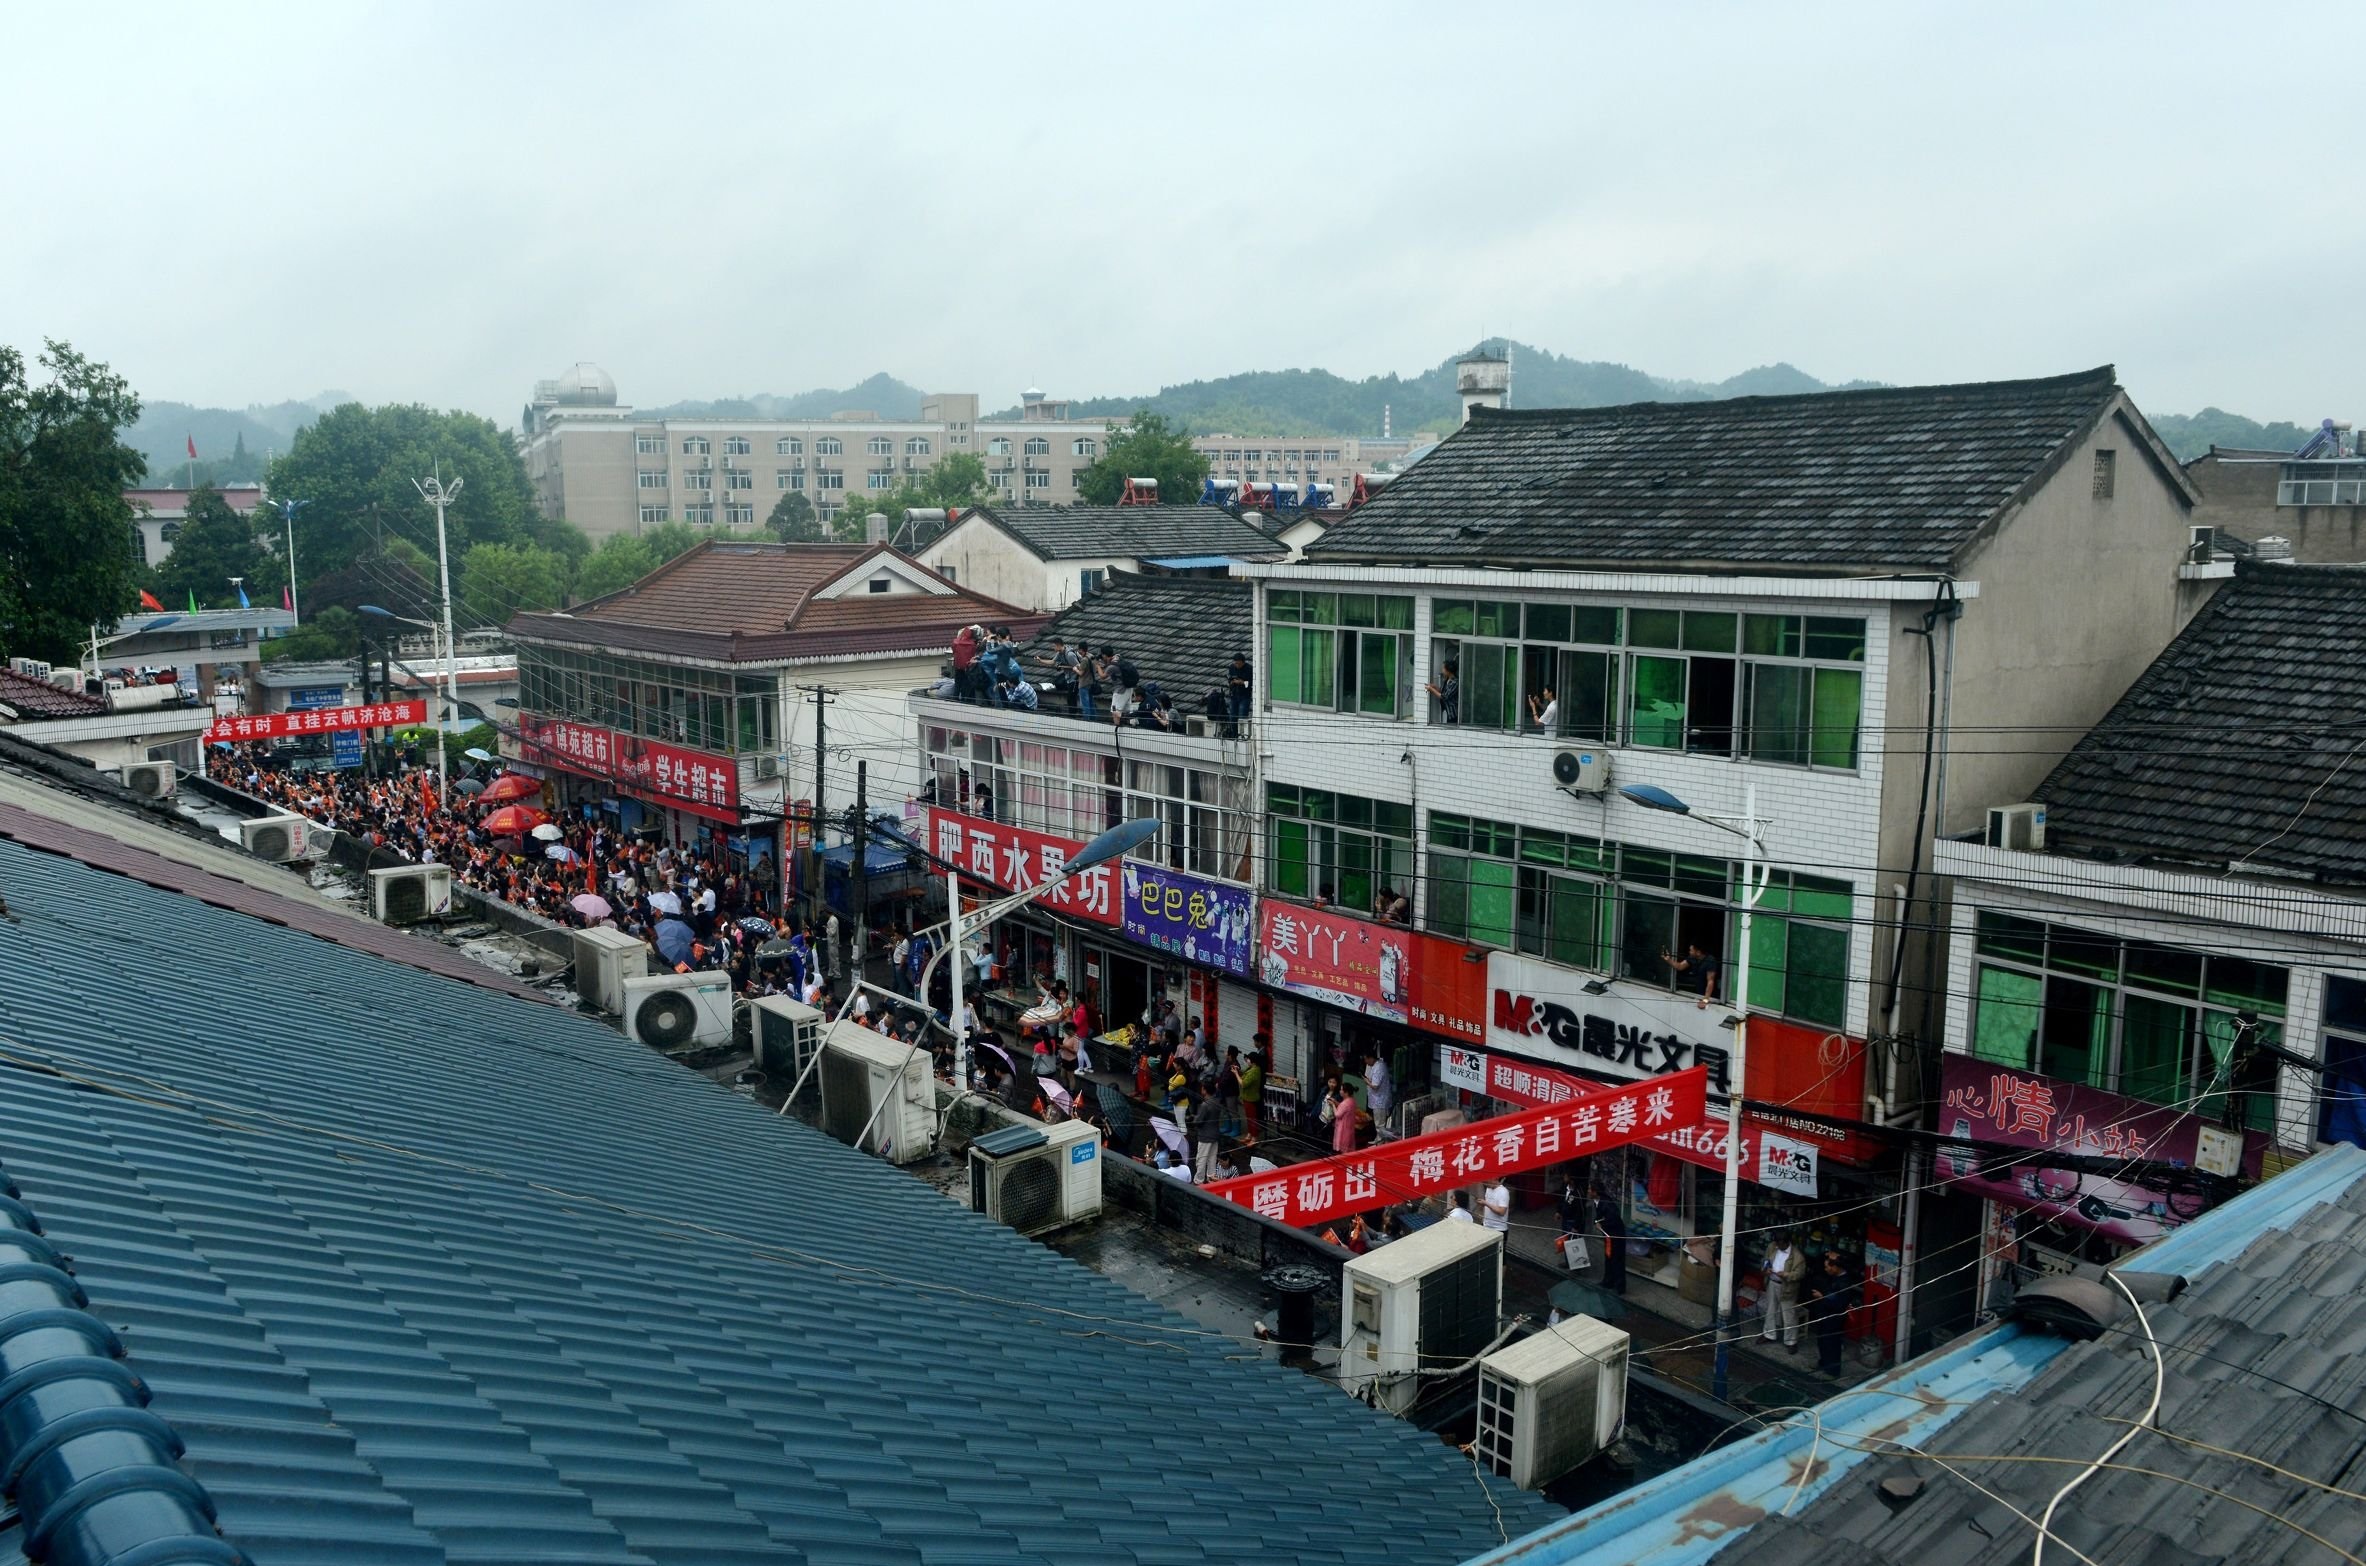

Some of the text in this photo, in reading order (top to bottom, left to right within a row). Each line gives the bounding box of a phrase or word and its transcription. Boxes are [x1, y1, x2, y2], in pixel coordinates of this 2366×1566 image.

[286, 705, 410, 730] 直挂云帆济沧海
[555, 724, 607, 762] 博苑超市
[656, 755, 726, 806] 学生超市
[938, 819, 1111, 915] 肥西水果坊
[1142, 881, 1207, 929] 巴巴兔
[1127, 920, 1145, 935] 时尚
[1271, 912, 1347, 966] 美丫丫
[1329, 975, 1349, 987] 工艺品
[1411, 1006, 1482, 1036] 时尚 文具 礼品 饰品
[1494, 988, 1580, 1049] M&G
[1450, 1050, 1480, 1071] M&G
[1582, 1013, 1732, 1094] 晨光文具
[1449, 1066, 1480, 1083] 晨光文具
[1494, 1064, 1585, 1103] 超顺滑晨
[1947, 1074, 2147, 1160] 心情小站
[1226, 1086, 1674, 1220] 磨砺出 梅花香自苦寒来
[1653, 1125, 1750, 1165] 试666
[1769, 1146, 1811, 1172] M&G
[1767, 1165, 1811, 1185] 晨光文具
